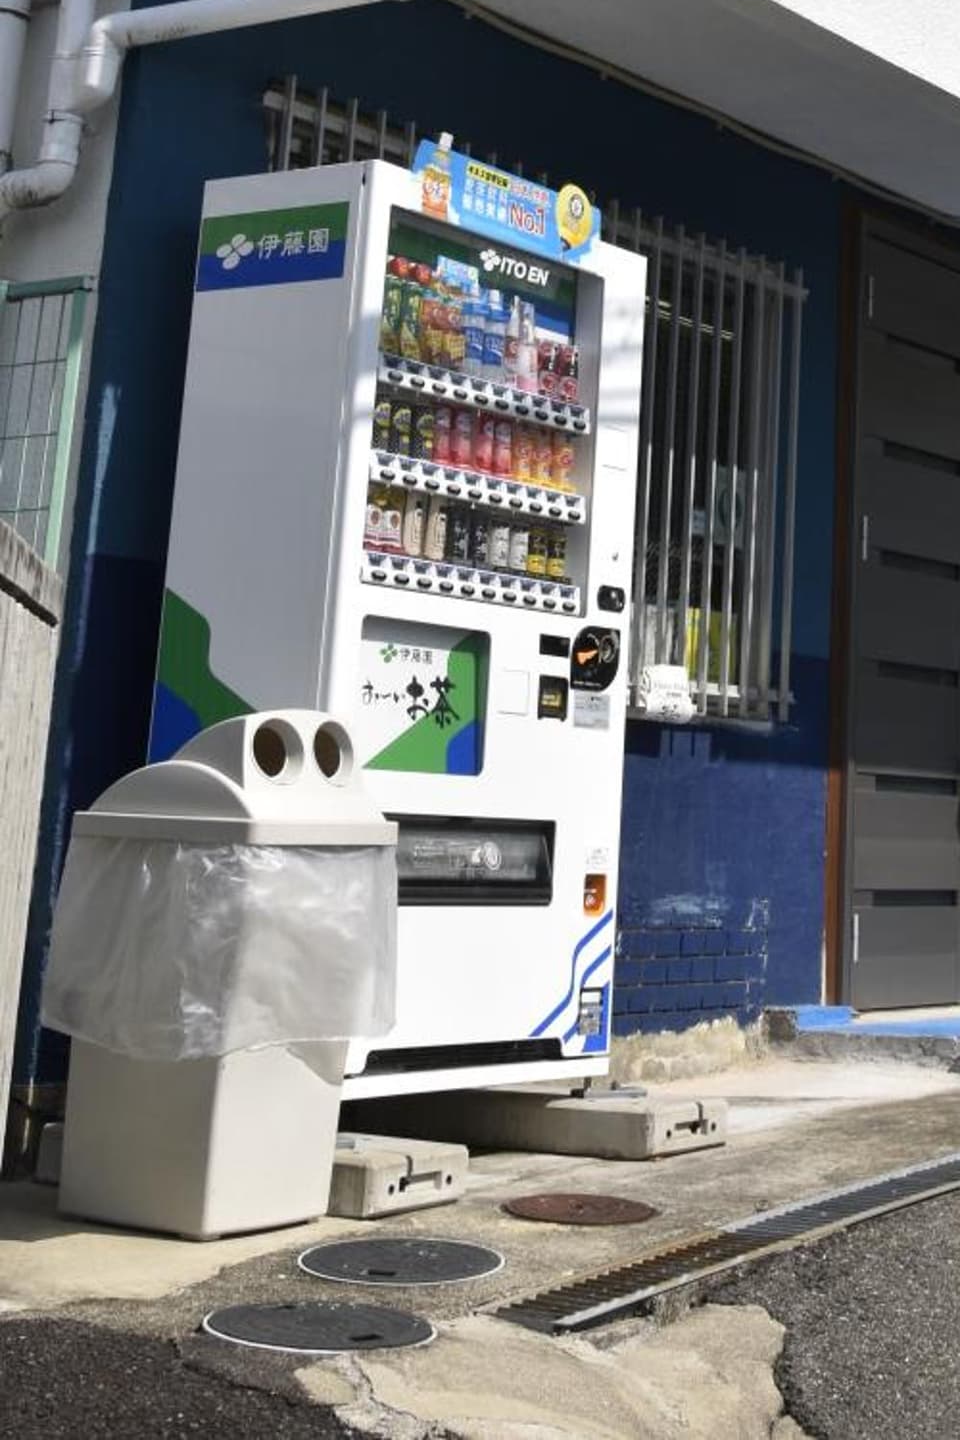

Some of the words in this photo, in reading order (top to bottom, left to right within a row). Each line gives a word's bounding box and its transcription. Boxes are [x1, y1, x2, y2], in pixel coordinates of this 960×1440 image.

[509, 203, 546, 236] No.1
[257, 227, 330, 260] 伊藤園
[500, 256, 528, 280] ITO
[527, 265, 551, 287] EN
